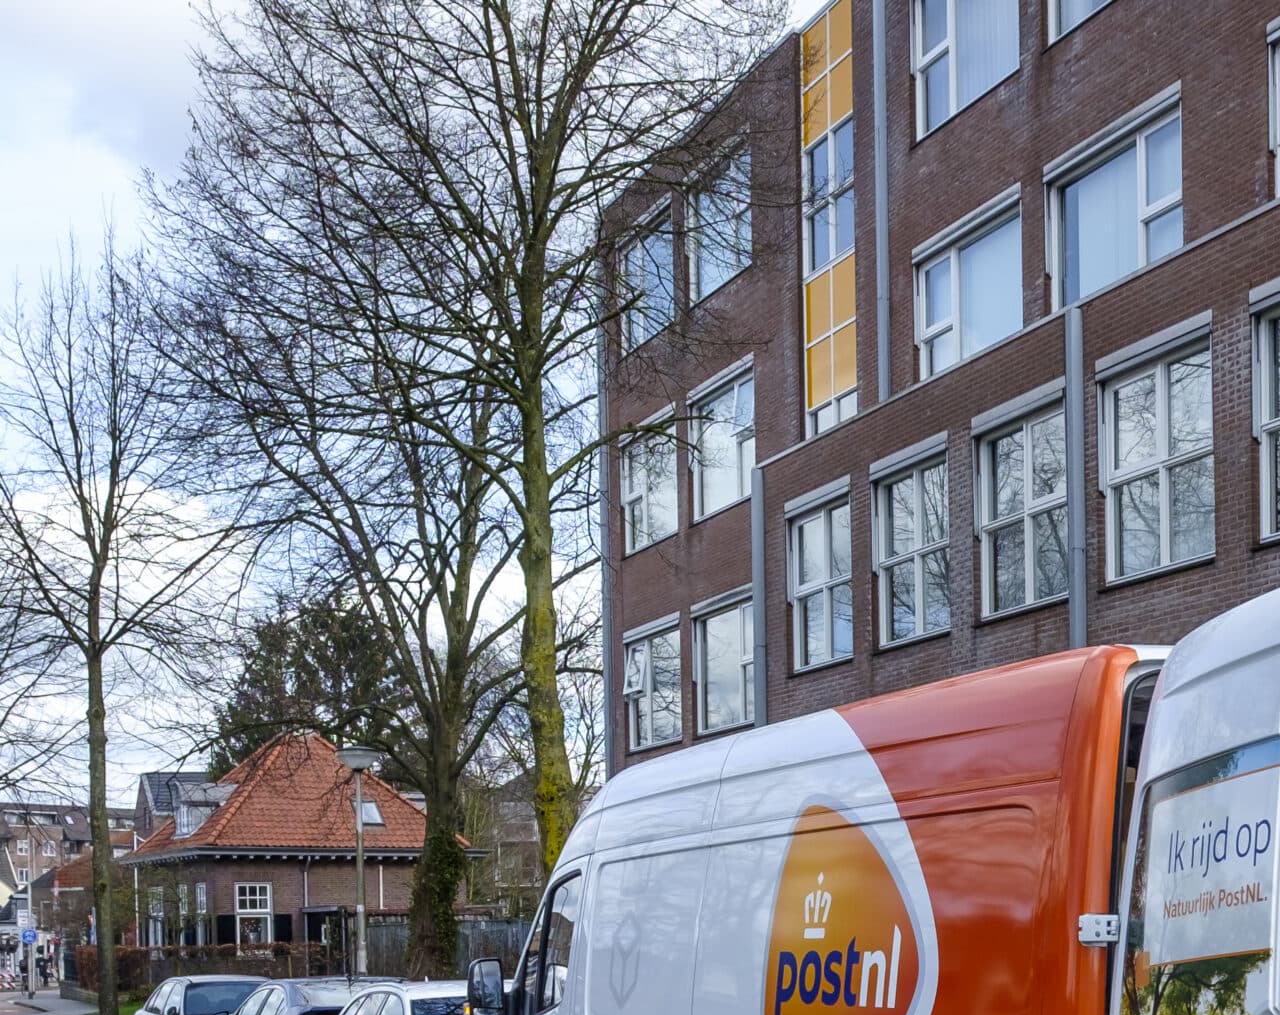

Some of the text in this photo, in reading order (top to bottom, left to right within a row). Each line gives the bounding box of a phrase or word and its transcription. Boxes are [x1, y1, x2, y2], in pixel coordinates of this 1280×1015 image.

[1167, 815, 1272, 878] Ik rijd op
[1163, 881, 1268, 919] Natuurlijk PostNL.
